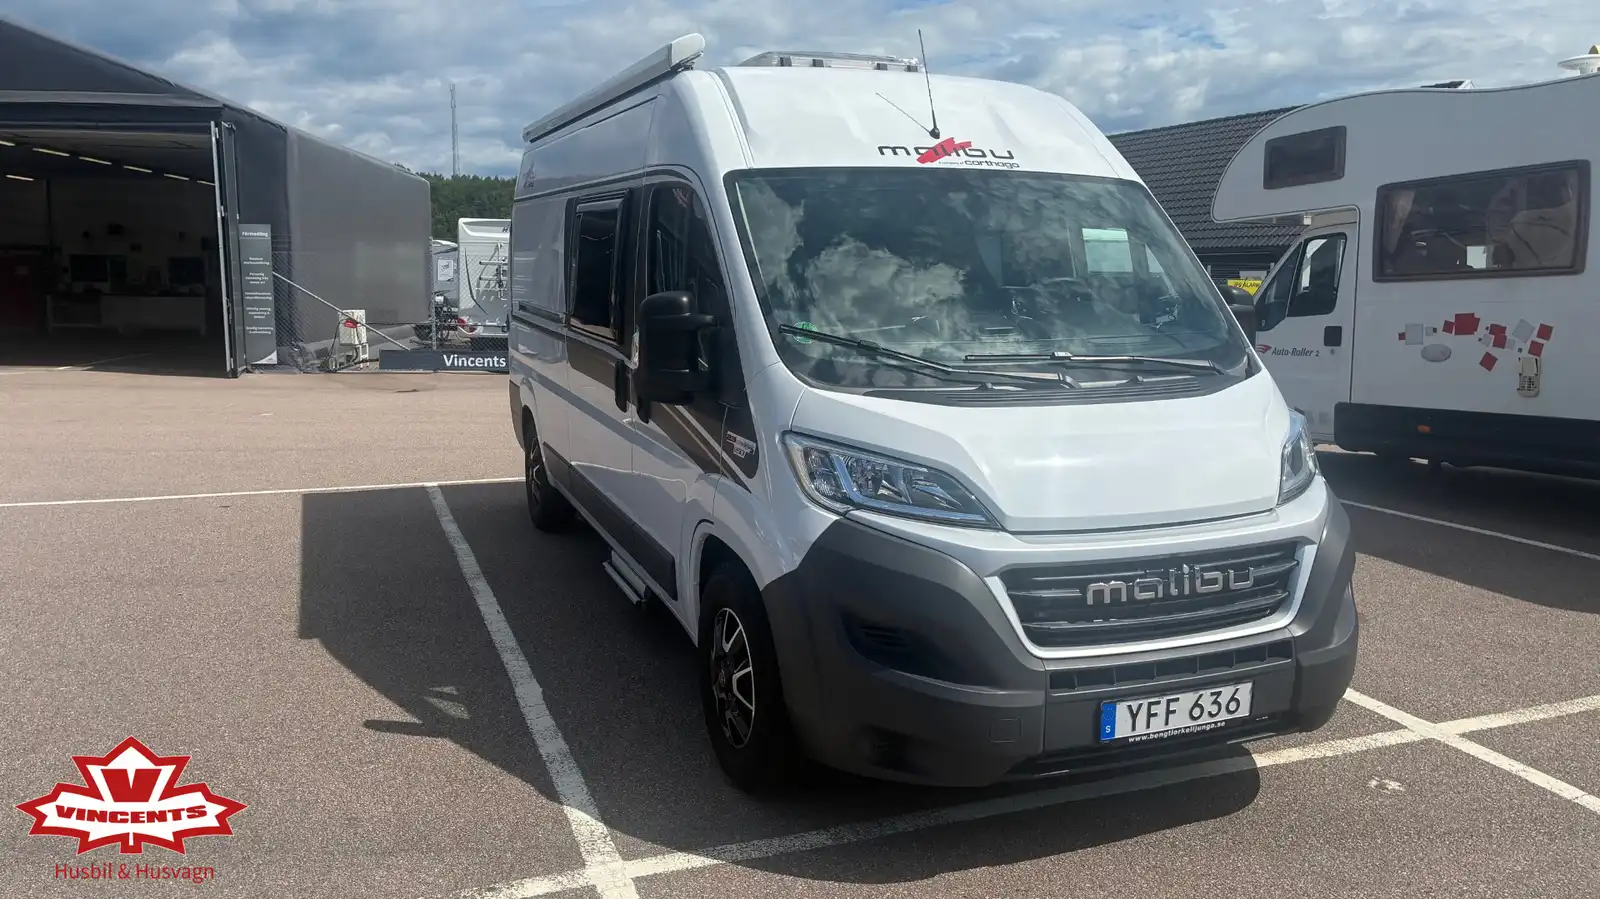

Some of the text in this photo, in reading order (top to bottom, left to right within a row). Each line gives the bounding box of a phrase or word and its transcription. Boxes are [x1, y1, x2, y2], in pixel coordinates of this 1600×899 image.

[877, 144, 1014, 160] malibu
[964, 160, 1020, 169] carthago
[1271, 347, 1313, 357] Auto-Roller
[443, 354, 507, 368] Vincents
[1087, 563, 1255, 606] malibu
[1105, 687, 1241, 733] S YFF 636
